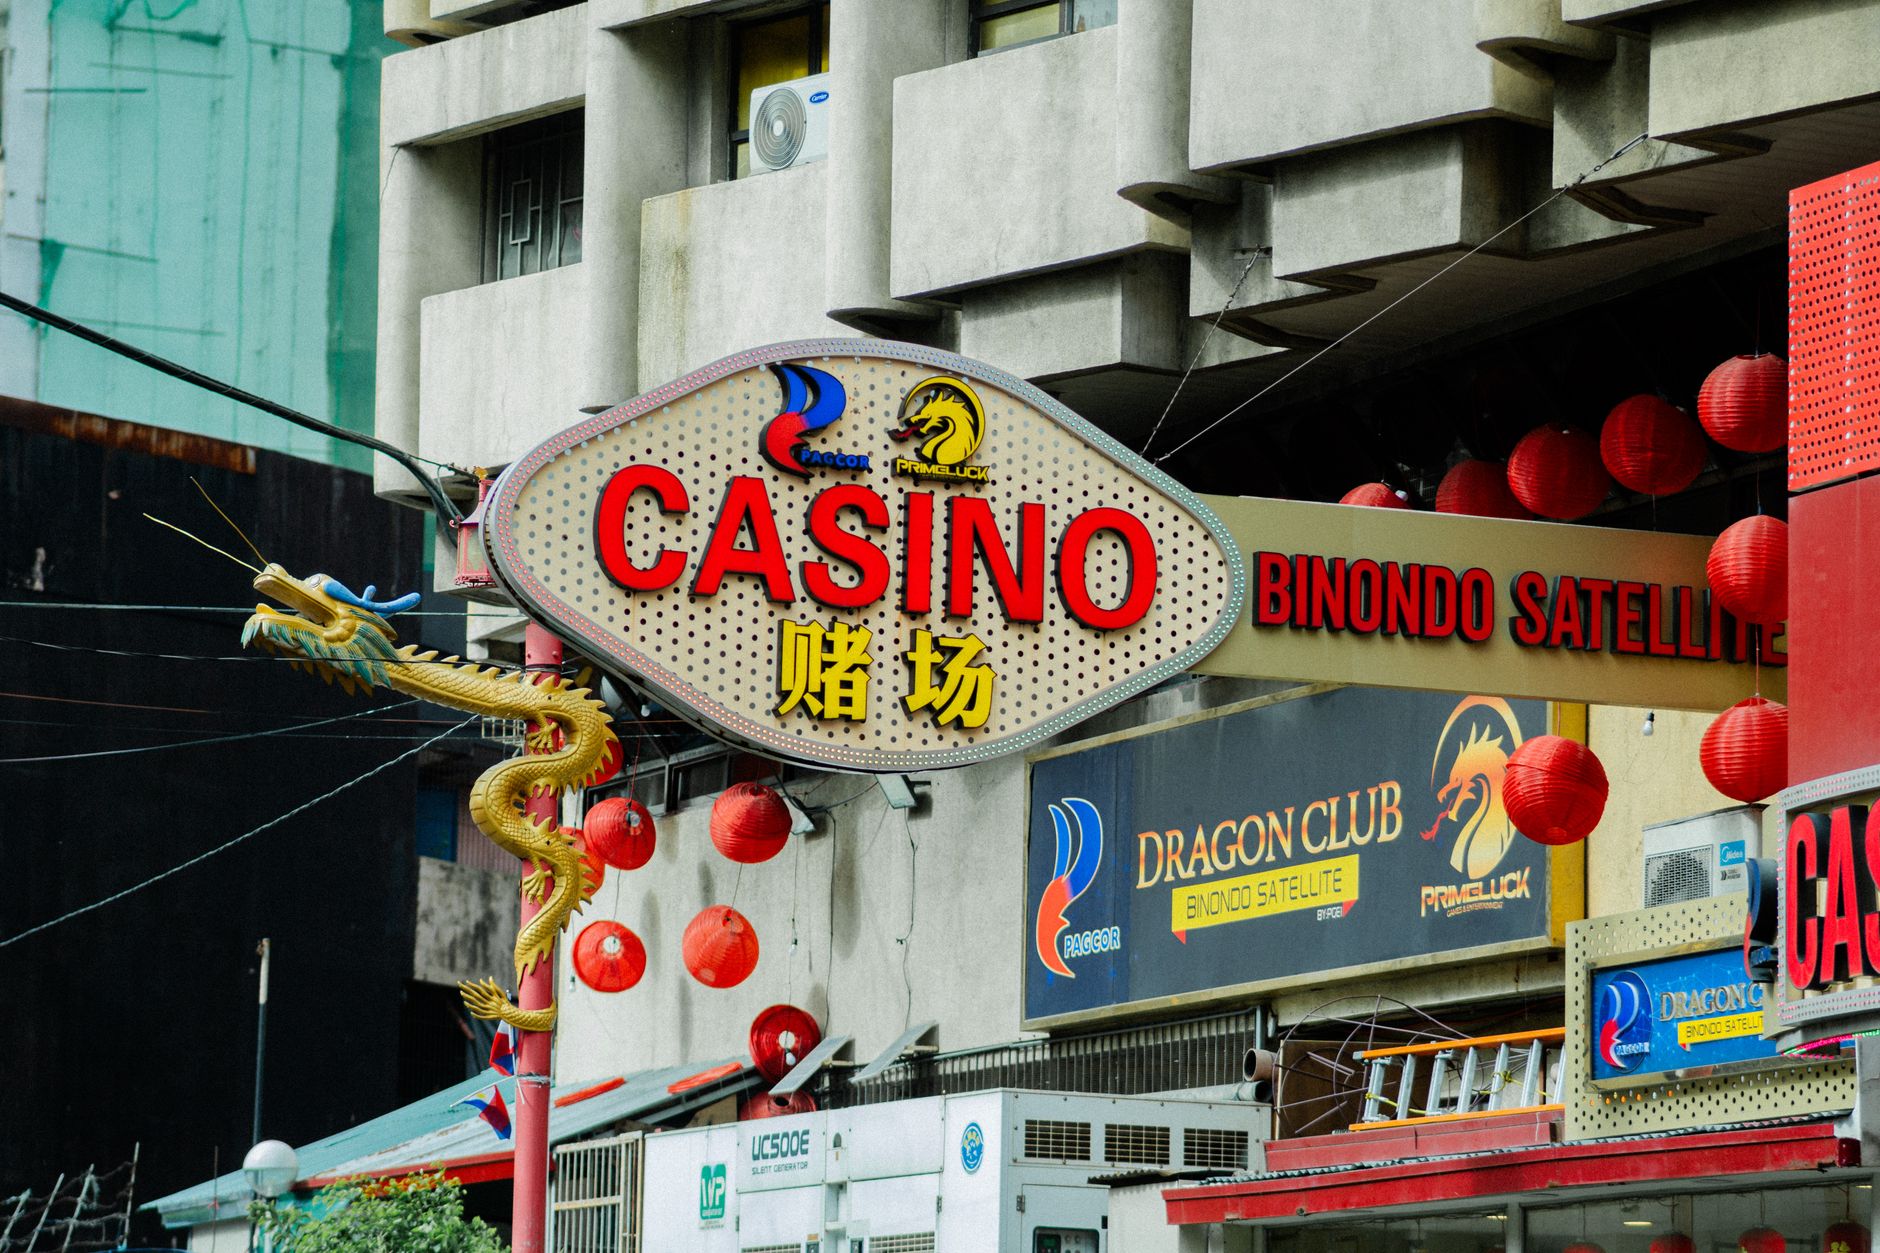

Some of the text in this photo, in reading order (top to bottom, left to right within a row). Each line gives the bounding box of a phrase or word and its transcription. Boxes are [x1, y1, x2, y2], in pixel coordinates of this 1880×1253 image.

[801, 449, 870, 469] PAGCOR
[896, 458, 990, 482] PRIMELUCK
[596, 464, 1157, 630] CASINO
[1254, 551, 1495, 643] BINONDO
[778, 619, 997, 729] 赌场
[1136, 780, 1403, 889] DRAGON CLUB
[1186, 866, 1343, 919] BINONDO SATELLITE
[1420, 866, 1531, 918] PRIMELUCK
[1063, 926, 1121, 959] PAGCOR
[1660, 982, 1746, 1022] DRAGON
[1686, 1021, 1722, 1039] BINONDO
[752, 1129, 809, 1161] UC500E
[751, 1161, 809, 1175] SILENT GENERATOR
